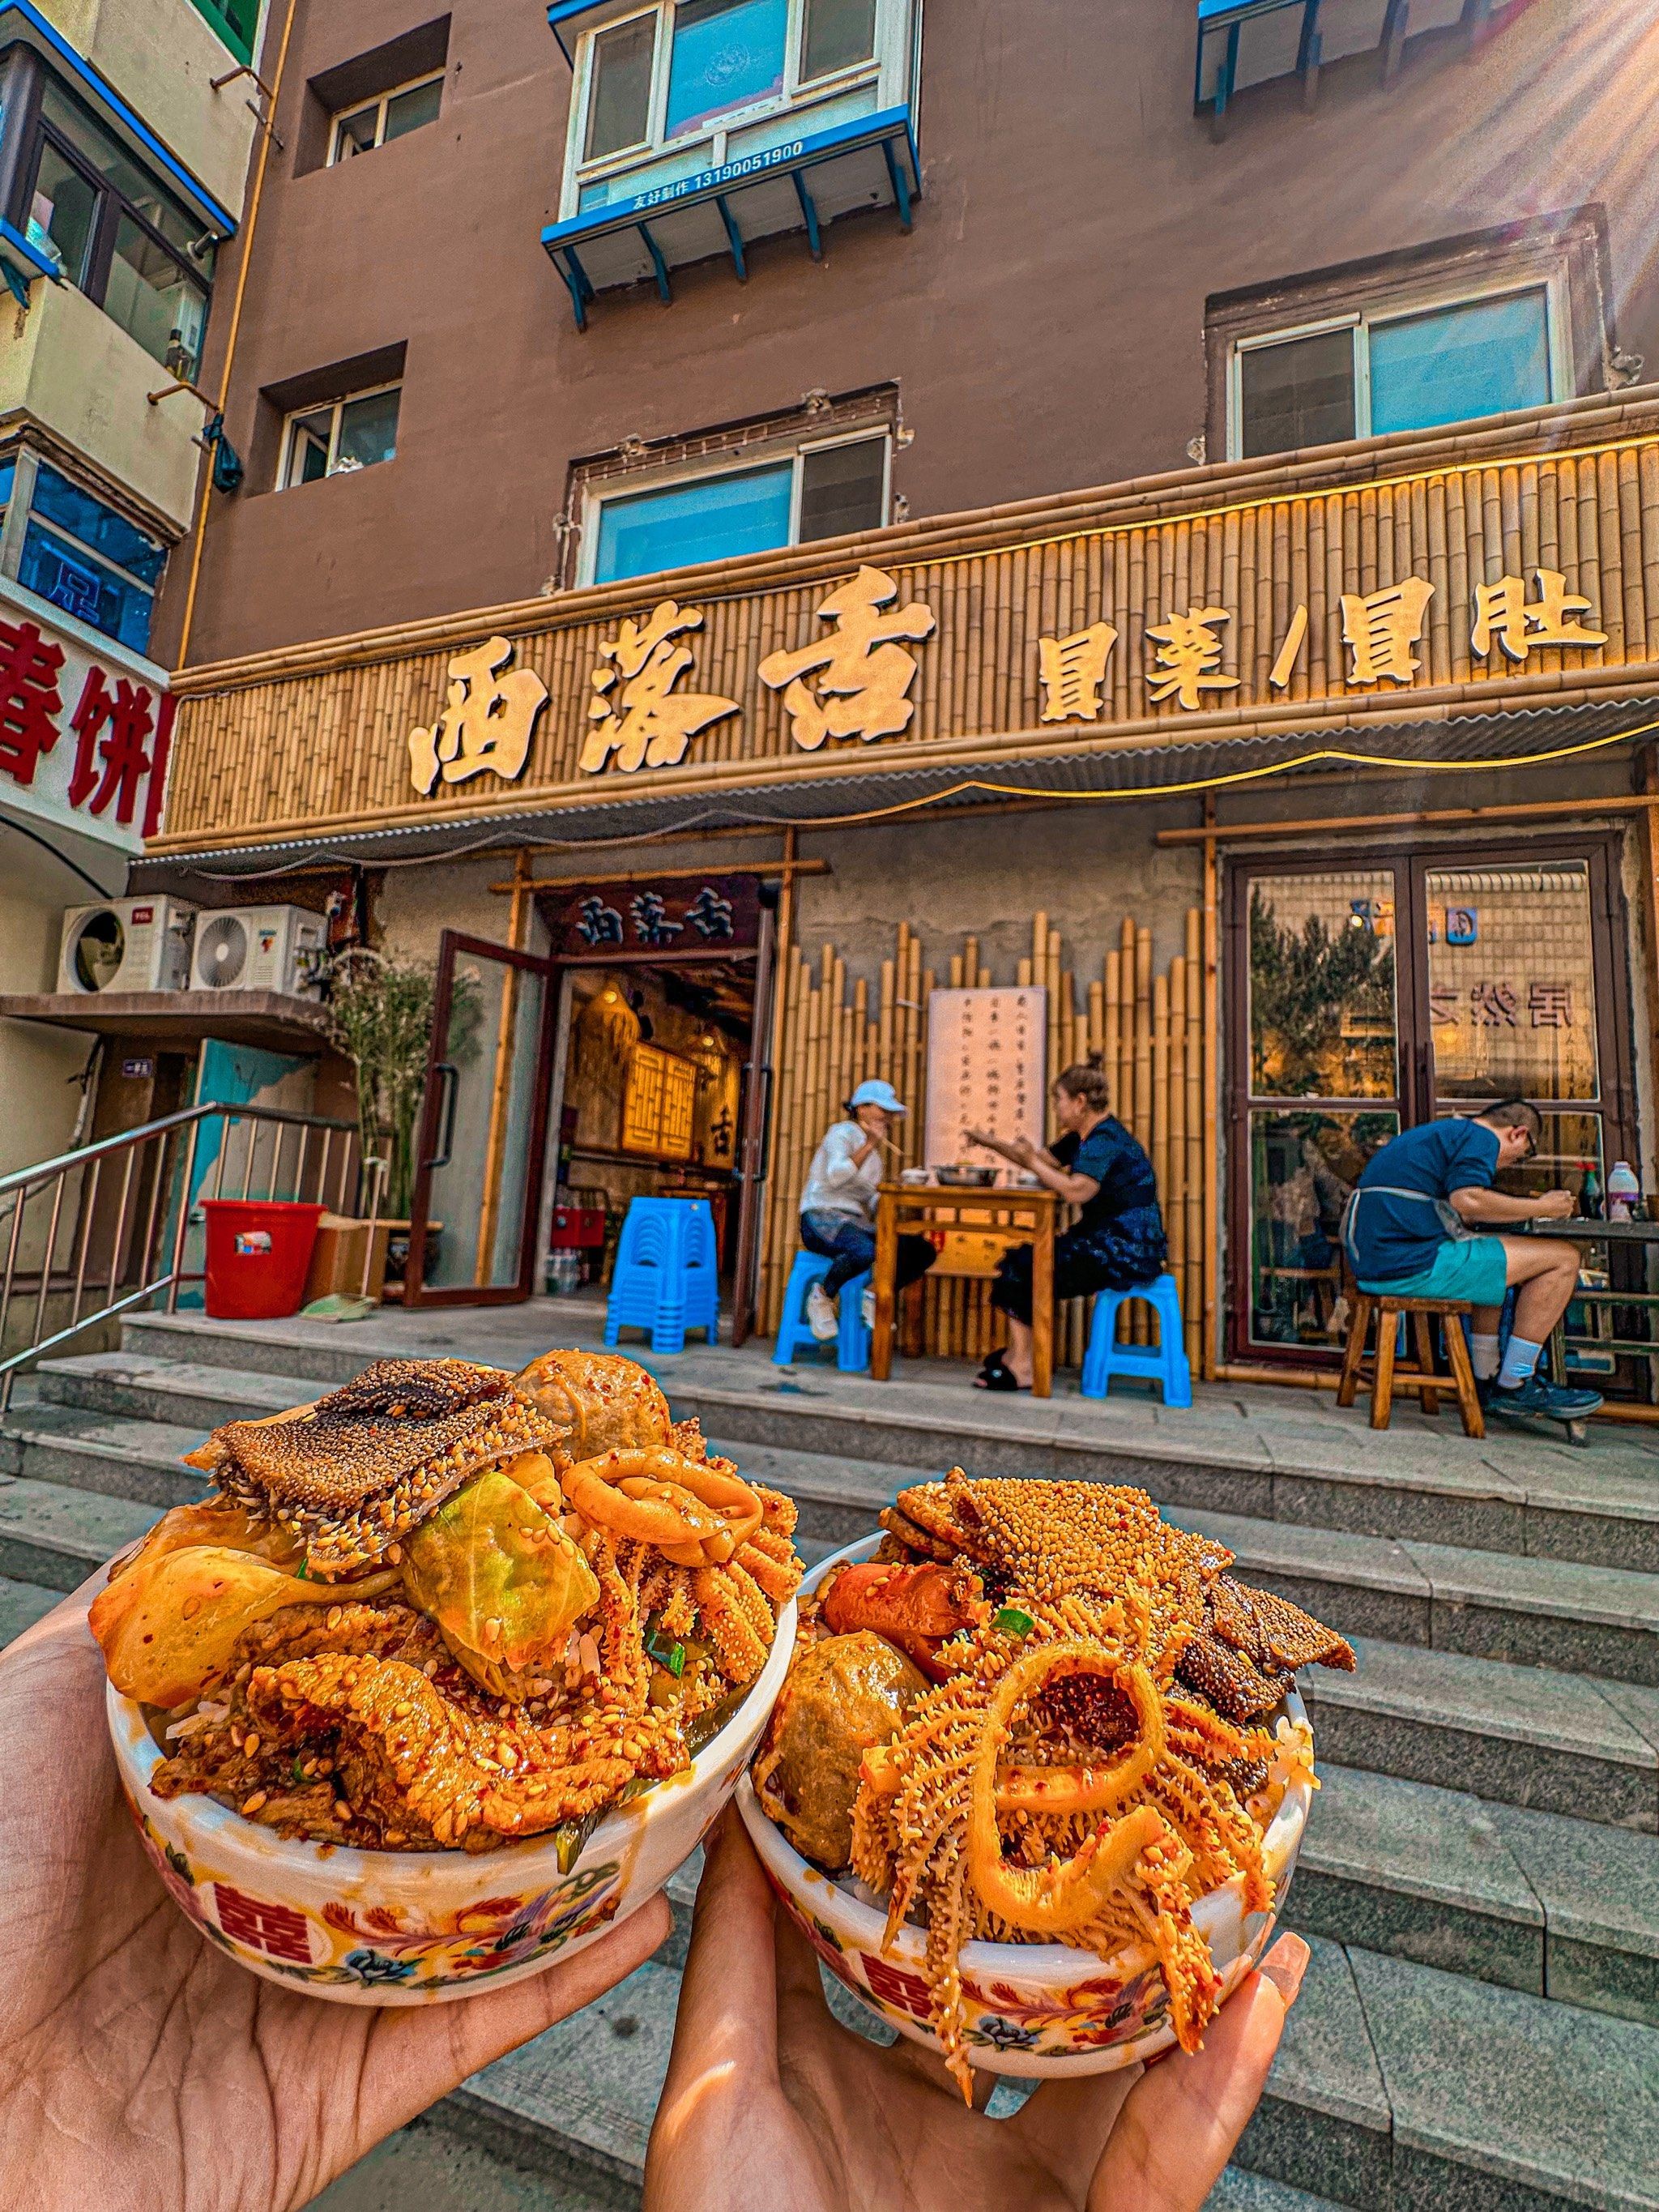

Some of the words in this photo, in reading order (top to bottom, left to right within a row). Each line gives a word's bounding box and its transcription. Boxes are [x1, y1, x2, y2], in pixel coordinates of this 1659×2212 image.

[633, 181, 689, 209] 友好制作
[695, 141, 804, 189] 13190051900
[0, 621, 154, 823] 春饼
